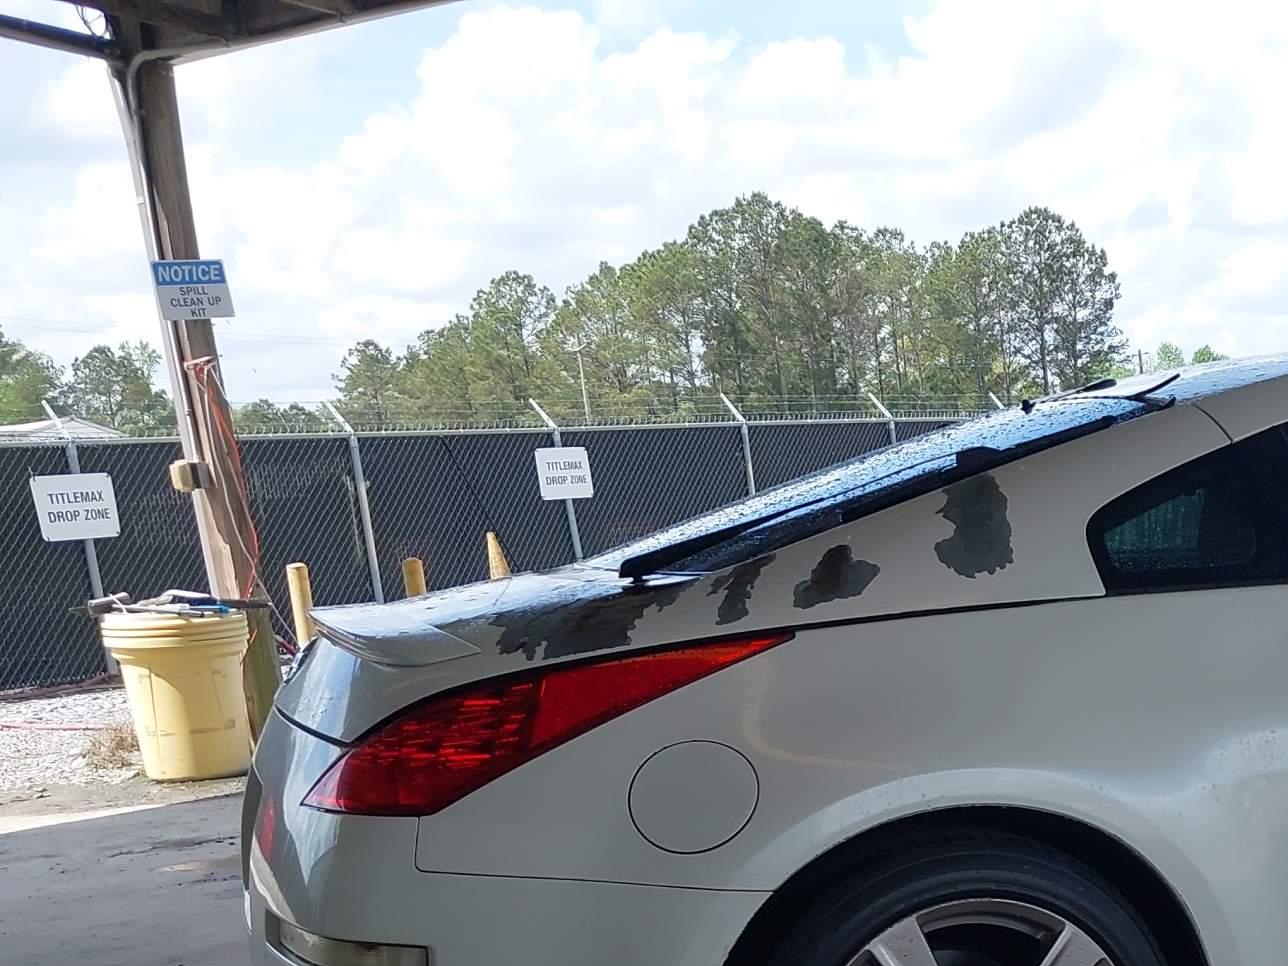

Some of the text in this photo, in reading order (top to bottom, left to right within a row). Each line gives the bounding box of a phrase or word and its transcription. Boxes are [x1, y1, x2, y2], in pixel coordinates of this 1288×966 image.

[157, 264, 221, 282] NOTICE
[179, 286, 208, 296] SPILL
[170, 296, 222, 307] CLEAN UP
[190, 308, 207, 318] KIT
[546, 461, 583, 471] TITLEMAX
[545, 474, 588, 485] DROP ZONE
[47, 490, 104, 504] TITLEMAX
[47, 508, 111, 523] DROP ZONE
